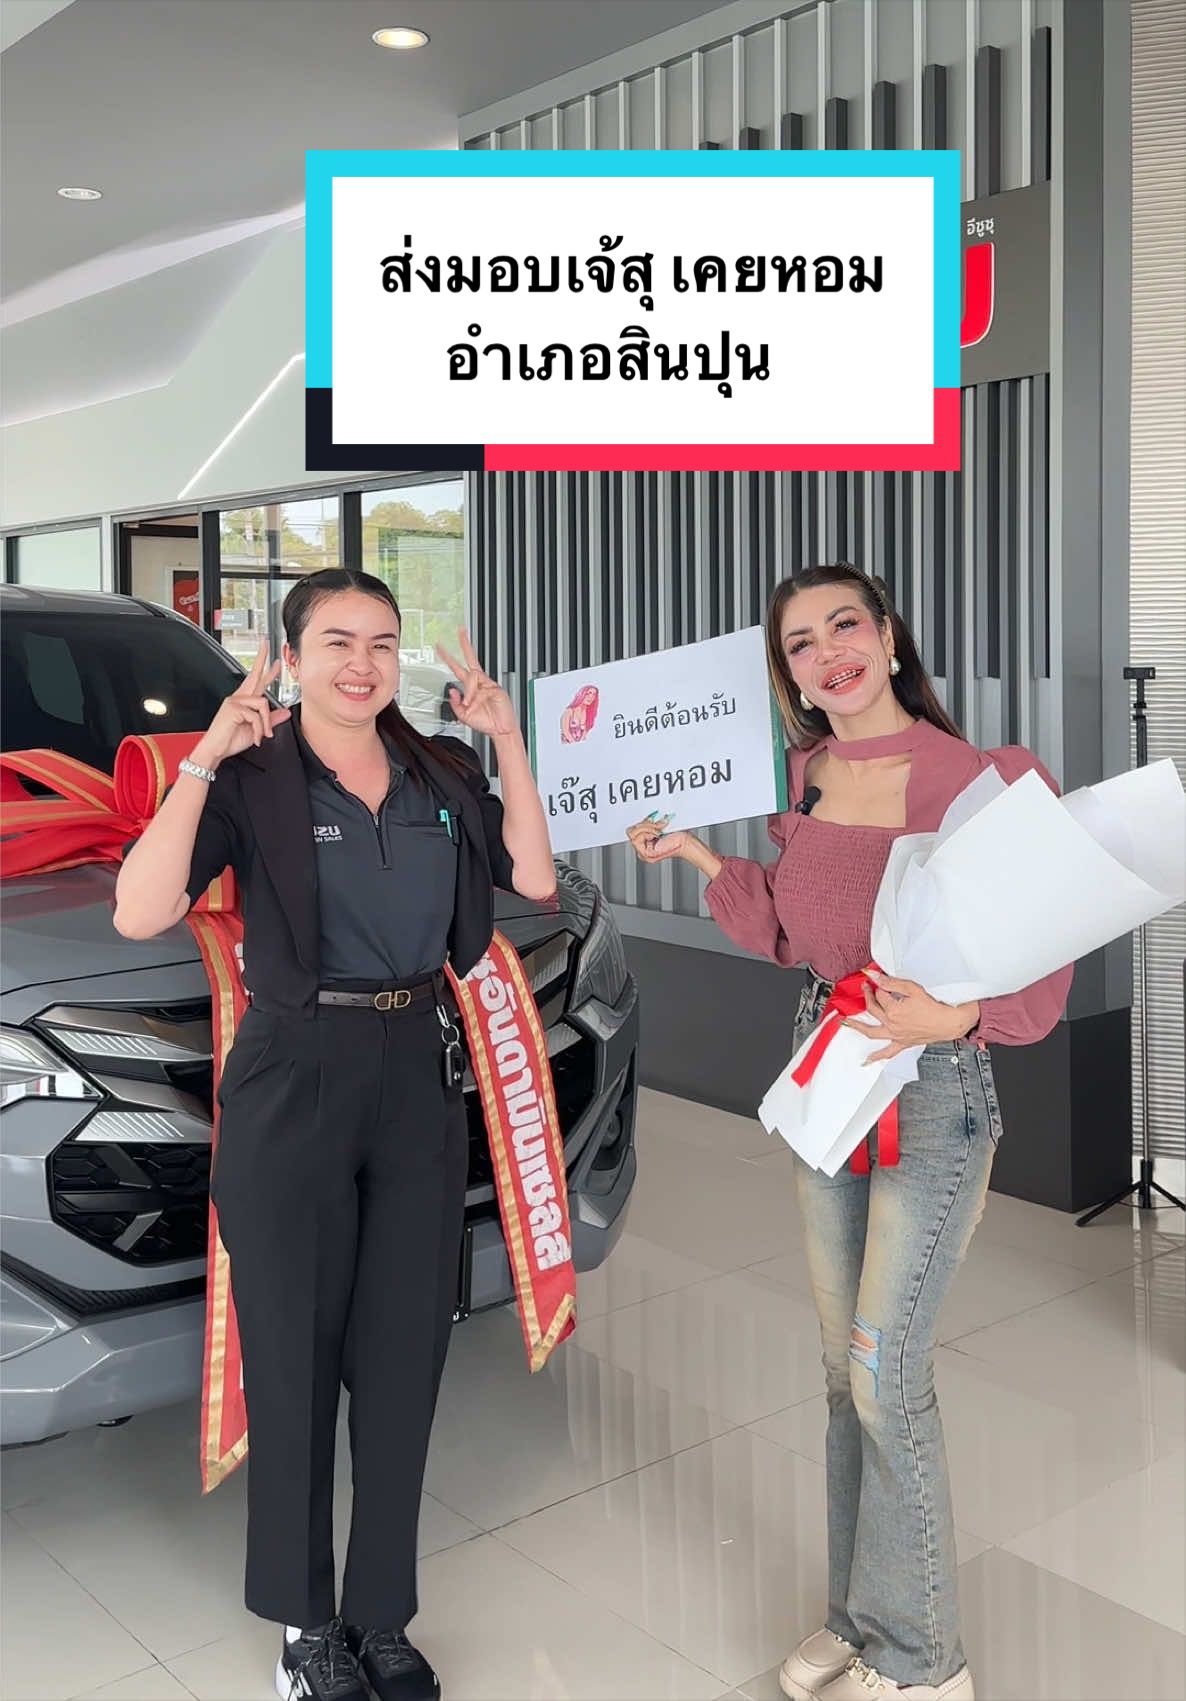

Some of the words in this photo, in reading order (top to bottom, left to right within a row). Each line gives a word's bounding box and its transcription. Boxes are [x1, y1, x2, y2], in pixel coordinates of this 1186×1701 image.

[613, 693, 736, 739] ยินดีต้อนรับ
[548, 776, 598, 824] เจ๊สุ
[608, 759, 732, 805] เคยหอม
